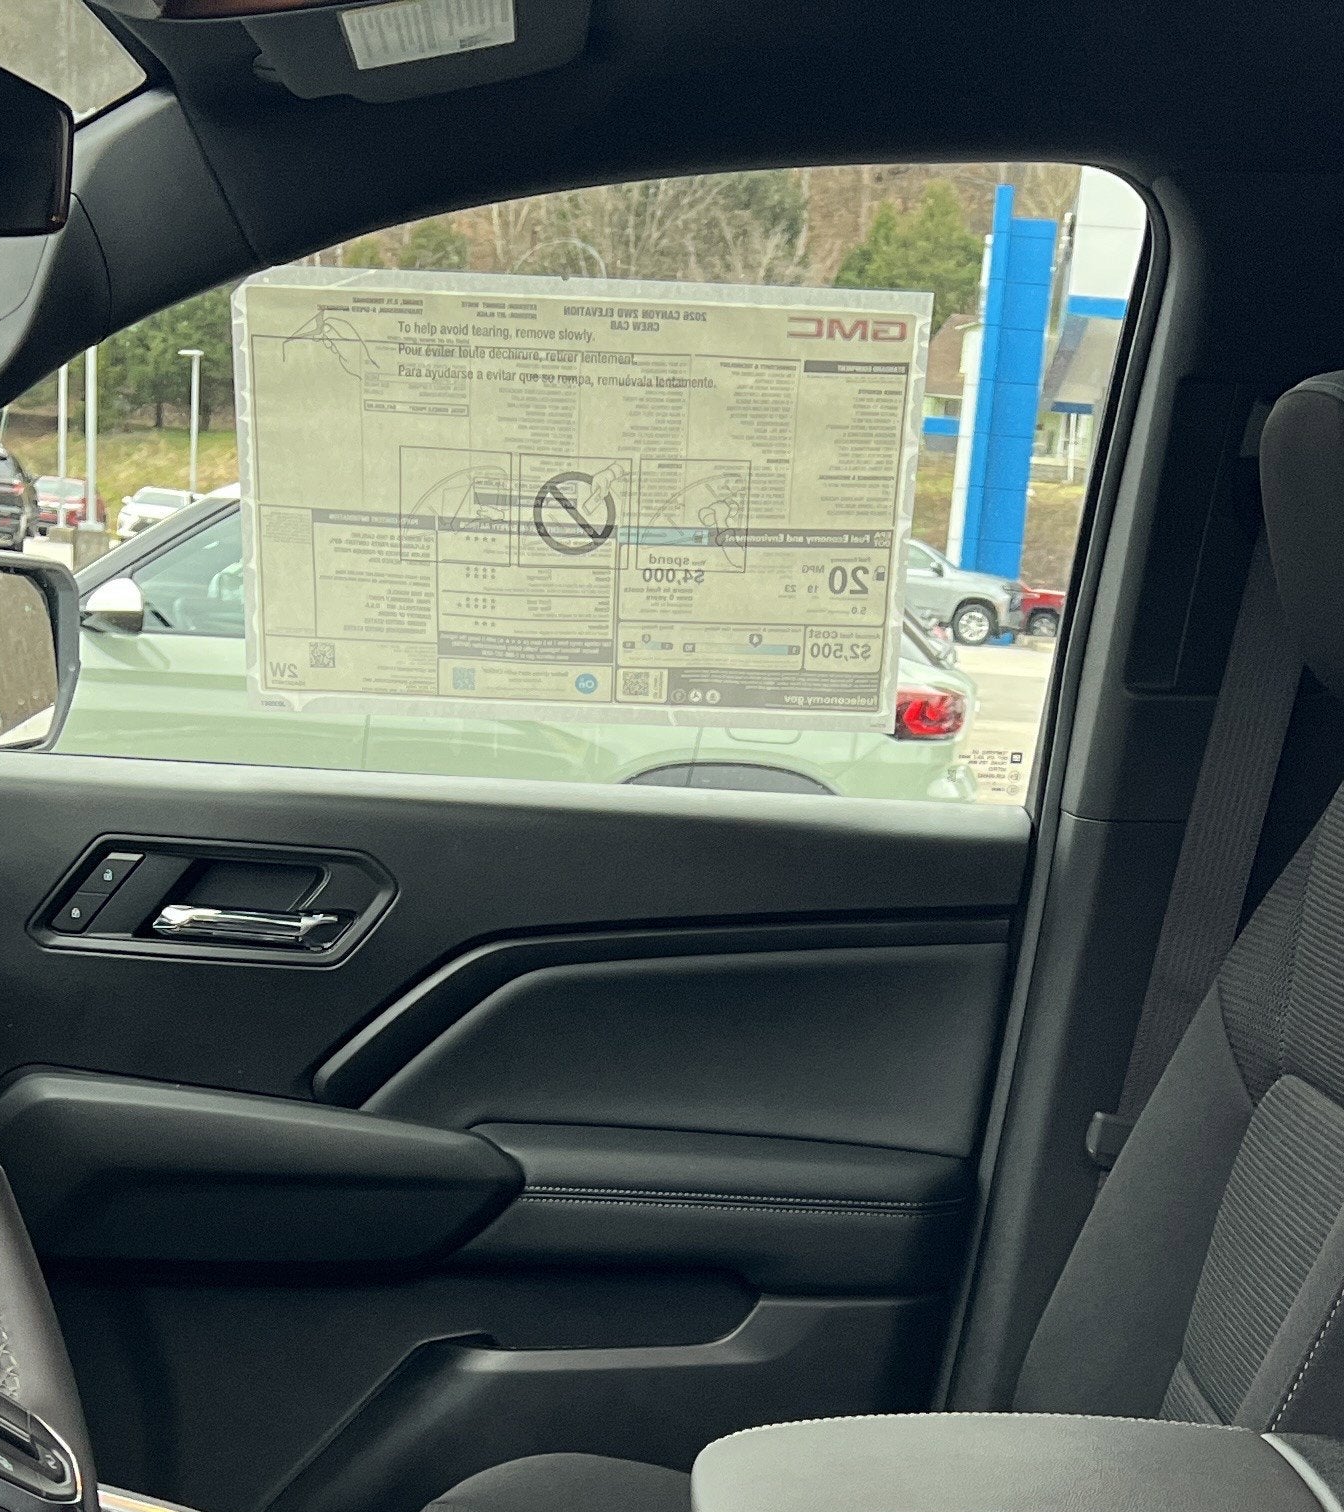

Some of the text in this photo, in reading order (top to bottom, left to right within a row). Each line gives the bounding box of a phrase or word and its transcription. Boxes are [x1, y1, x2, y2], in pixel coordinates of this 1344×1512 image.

[398, 321, 411, 332] To
[414, 322, 436, 336] help
[440, 324, 468, 336] avoid
[472, 324, 511, 340] tearing,
[516, 329, 555, 340] remove
[559, 328, 595, 343] slowly.
[398, 343, 422, 356] Pour
[458, 346, 485, 359] toute
[398, 364, 421, 377] Para
[424, 365, 473, 380] ayudarse
[477, 370, 483, 380] a
[486, 370, 516, 382] evitar
[519, 373, 538, 384] que
[656, 375, 716, 389] lentamente.
